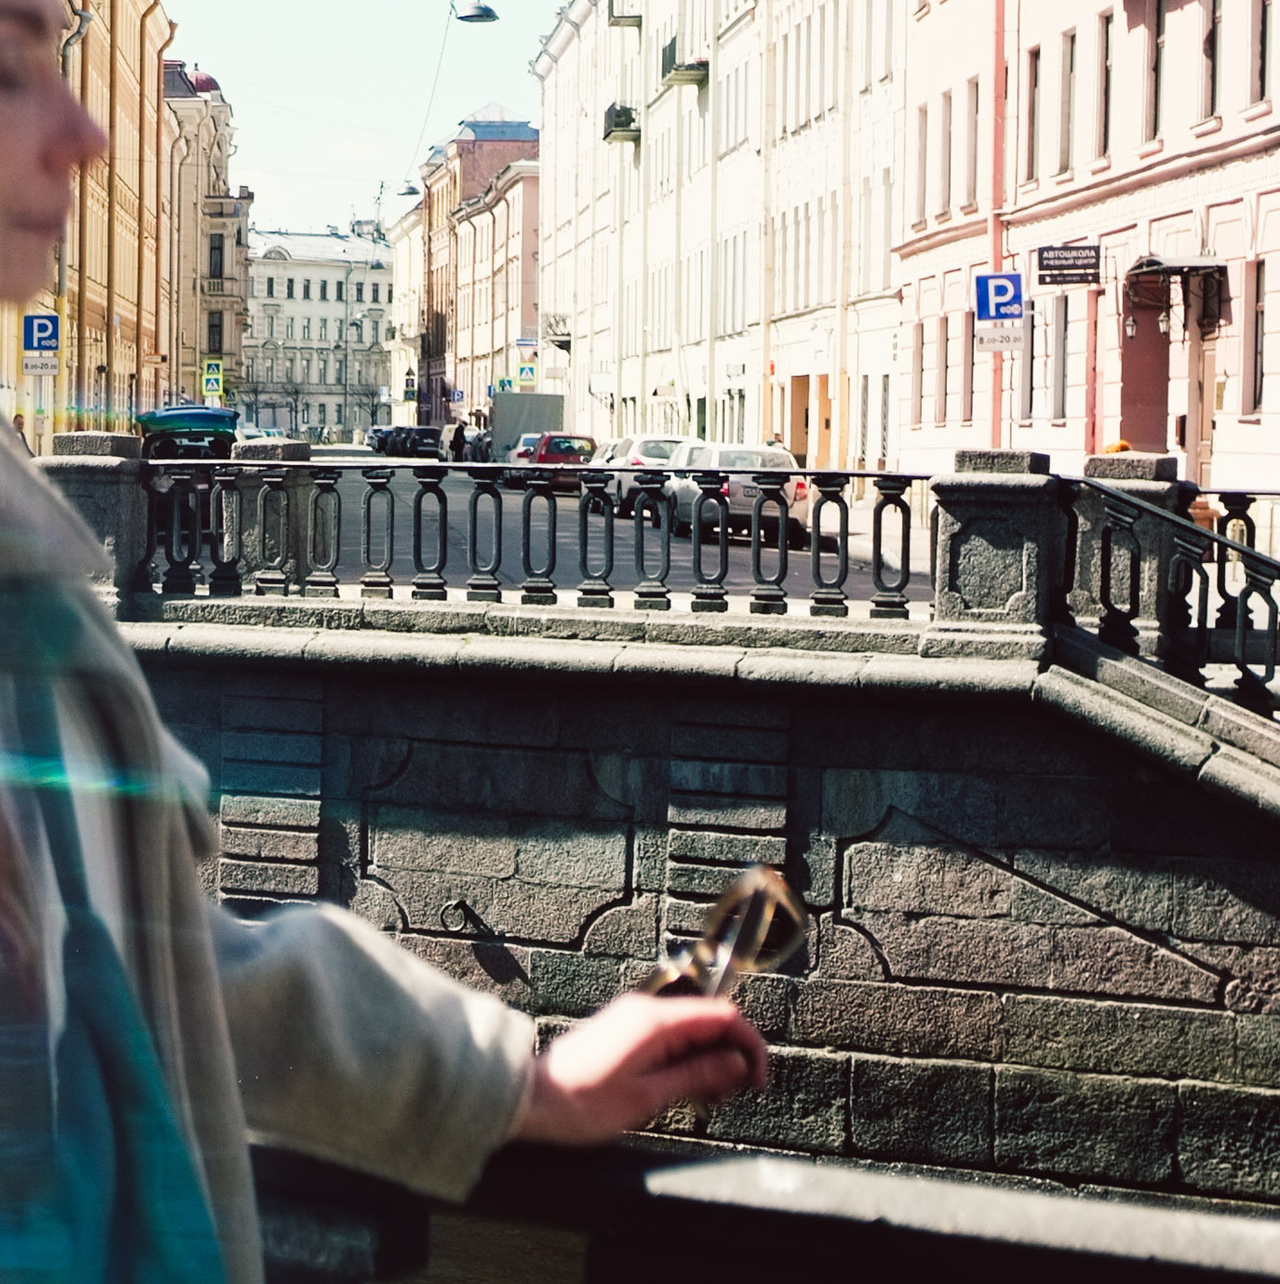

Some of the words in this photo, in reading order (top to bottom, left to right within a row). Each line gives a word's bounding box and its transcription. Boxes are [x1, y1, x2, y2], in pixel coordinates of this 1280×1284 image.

[1042, 249, 1096, 258] АВТОШКОЛА
[988, 278, 1015, 317] P
[33, 318, 53, 347] P
